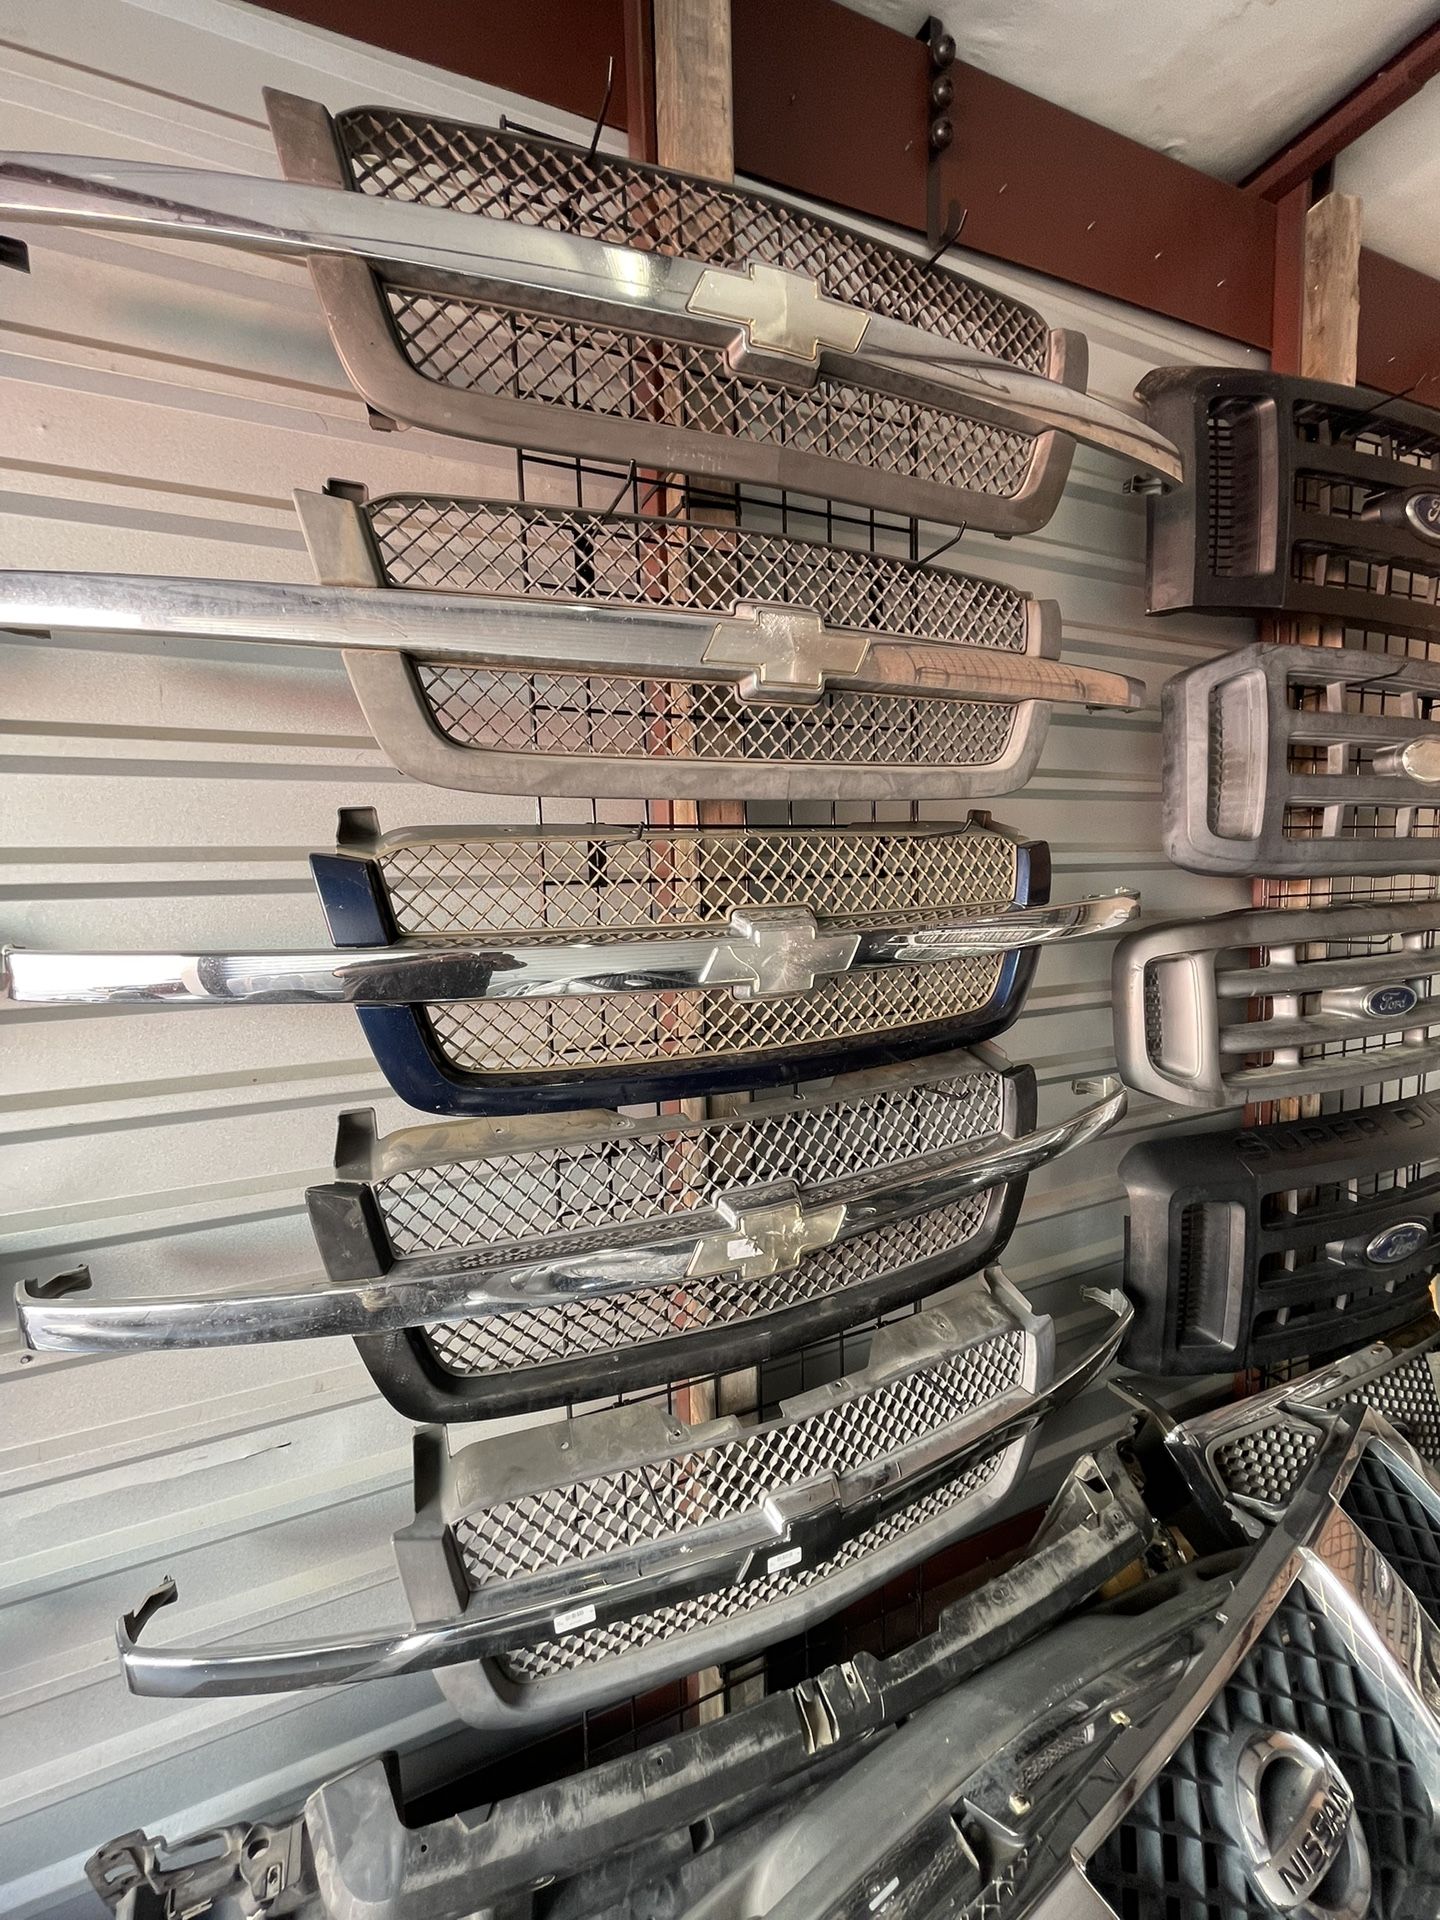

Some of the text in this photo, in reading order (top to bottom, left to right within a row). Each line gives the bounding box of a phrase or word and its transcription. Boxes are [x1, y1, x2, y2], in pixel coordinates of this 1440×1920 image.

[1379, 992, 1407, 1011] Ford
[1233, 1115, 1388, 1158] SUPER
[1387, 1232, 1421, 1257] Ford
[1278, 1775, 1352, 1895] NISSAN
